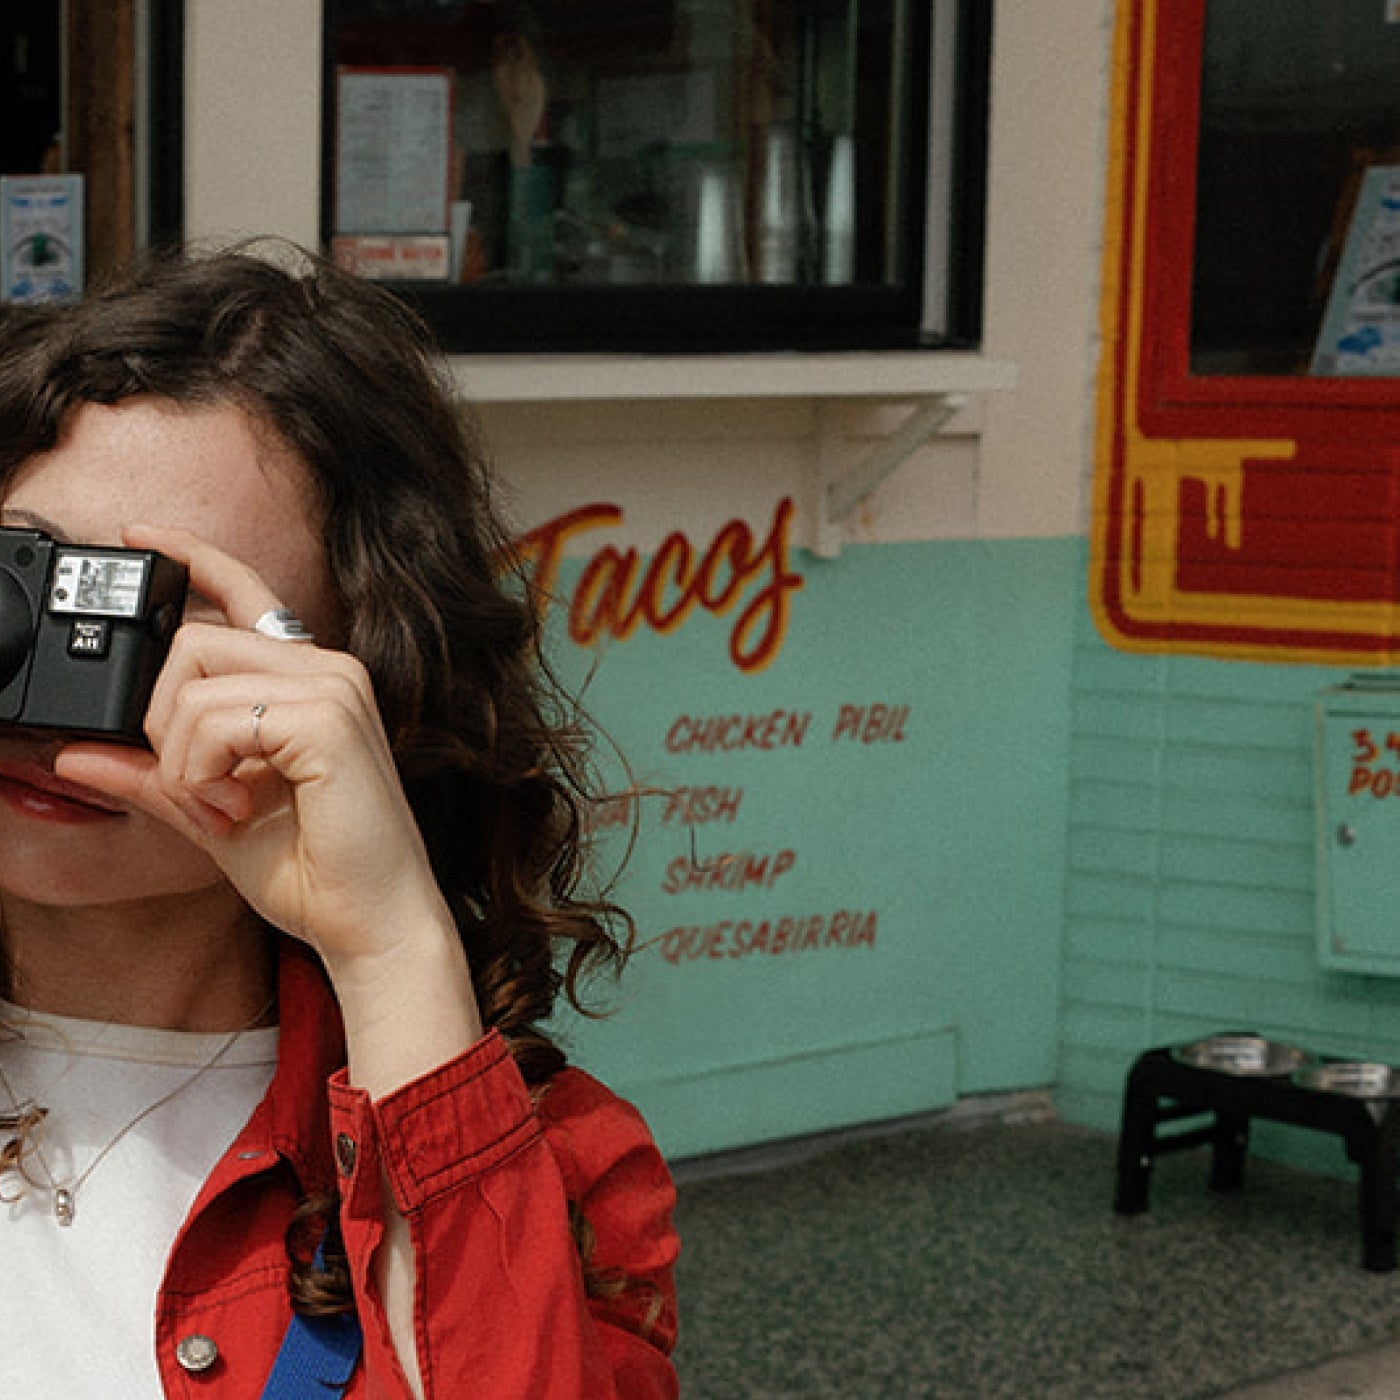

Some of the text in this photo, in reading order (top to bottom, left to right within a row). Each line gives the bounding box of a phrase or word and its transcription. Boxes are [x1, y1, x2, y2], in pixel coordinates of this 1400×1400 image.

[496, 496, 804, 674] Tacos
[666, 703, 909, 752] CHICKEN PIBIL
[664, 785, 743, 825] FISH
[661, 850, 796, 895] SHRIMP
[661, 911, 878, 965] QUESABIRRIA
